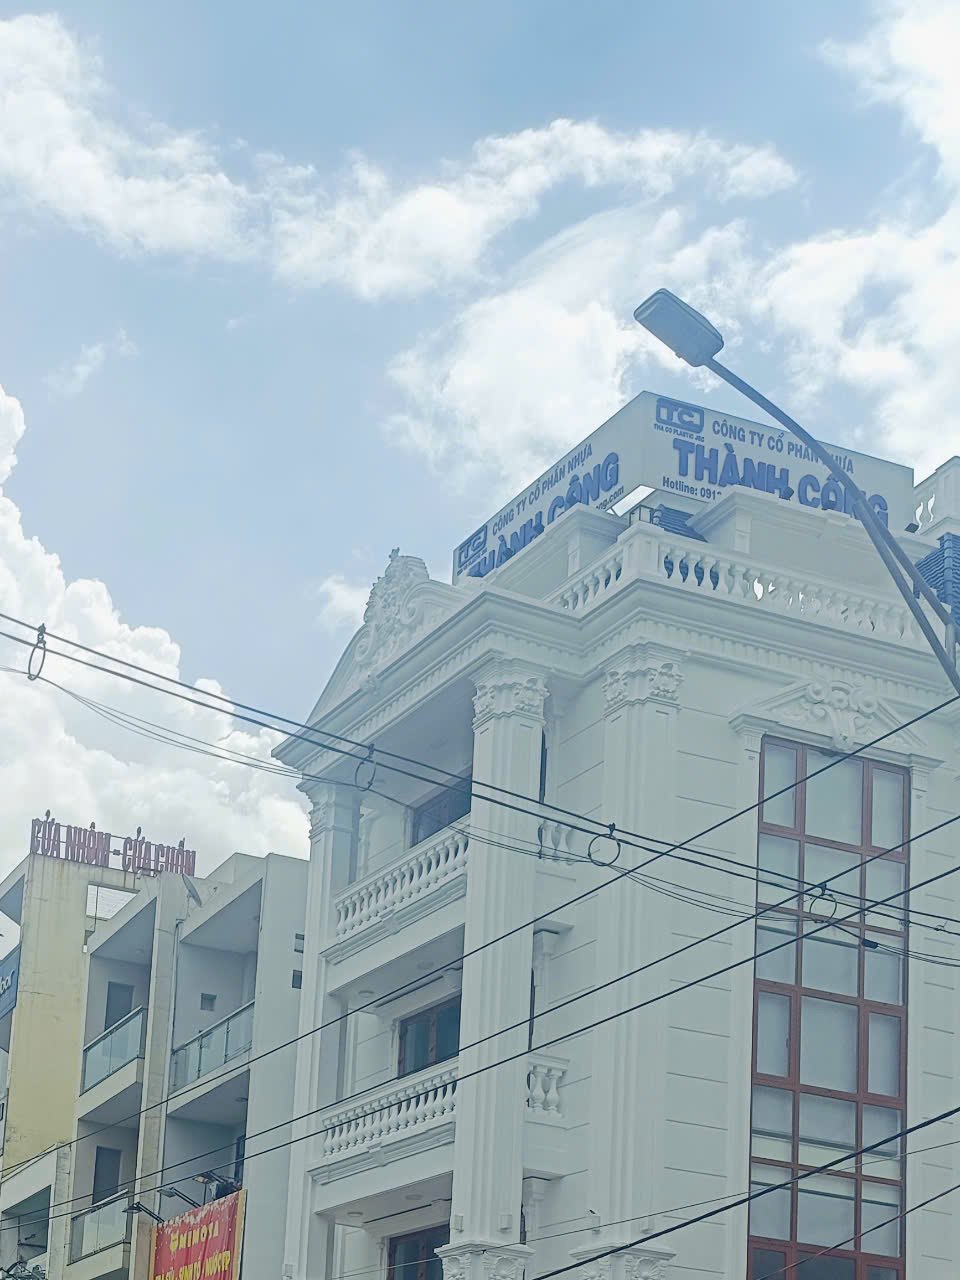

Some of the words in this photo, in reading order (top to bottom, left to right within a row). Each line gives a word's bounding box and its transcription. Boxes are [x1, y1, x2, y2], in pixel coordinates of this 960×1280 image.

[712, 419, 746, 442] CÔNG
[749, 430, 764, 448] TY
[767, 431, 784, 453] CỔ
[673, 438, 789, 498] THÀNH
[662, 476, 698, 496] Hotline:
[700, 486, 722, 500] 091
[492, 509, 515, 536] CÔNG
[516, 497, 528, 515] TY
